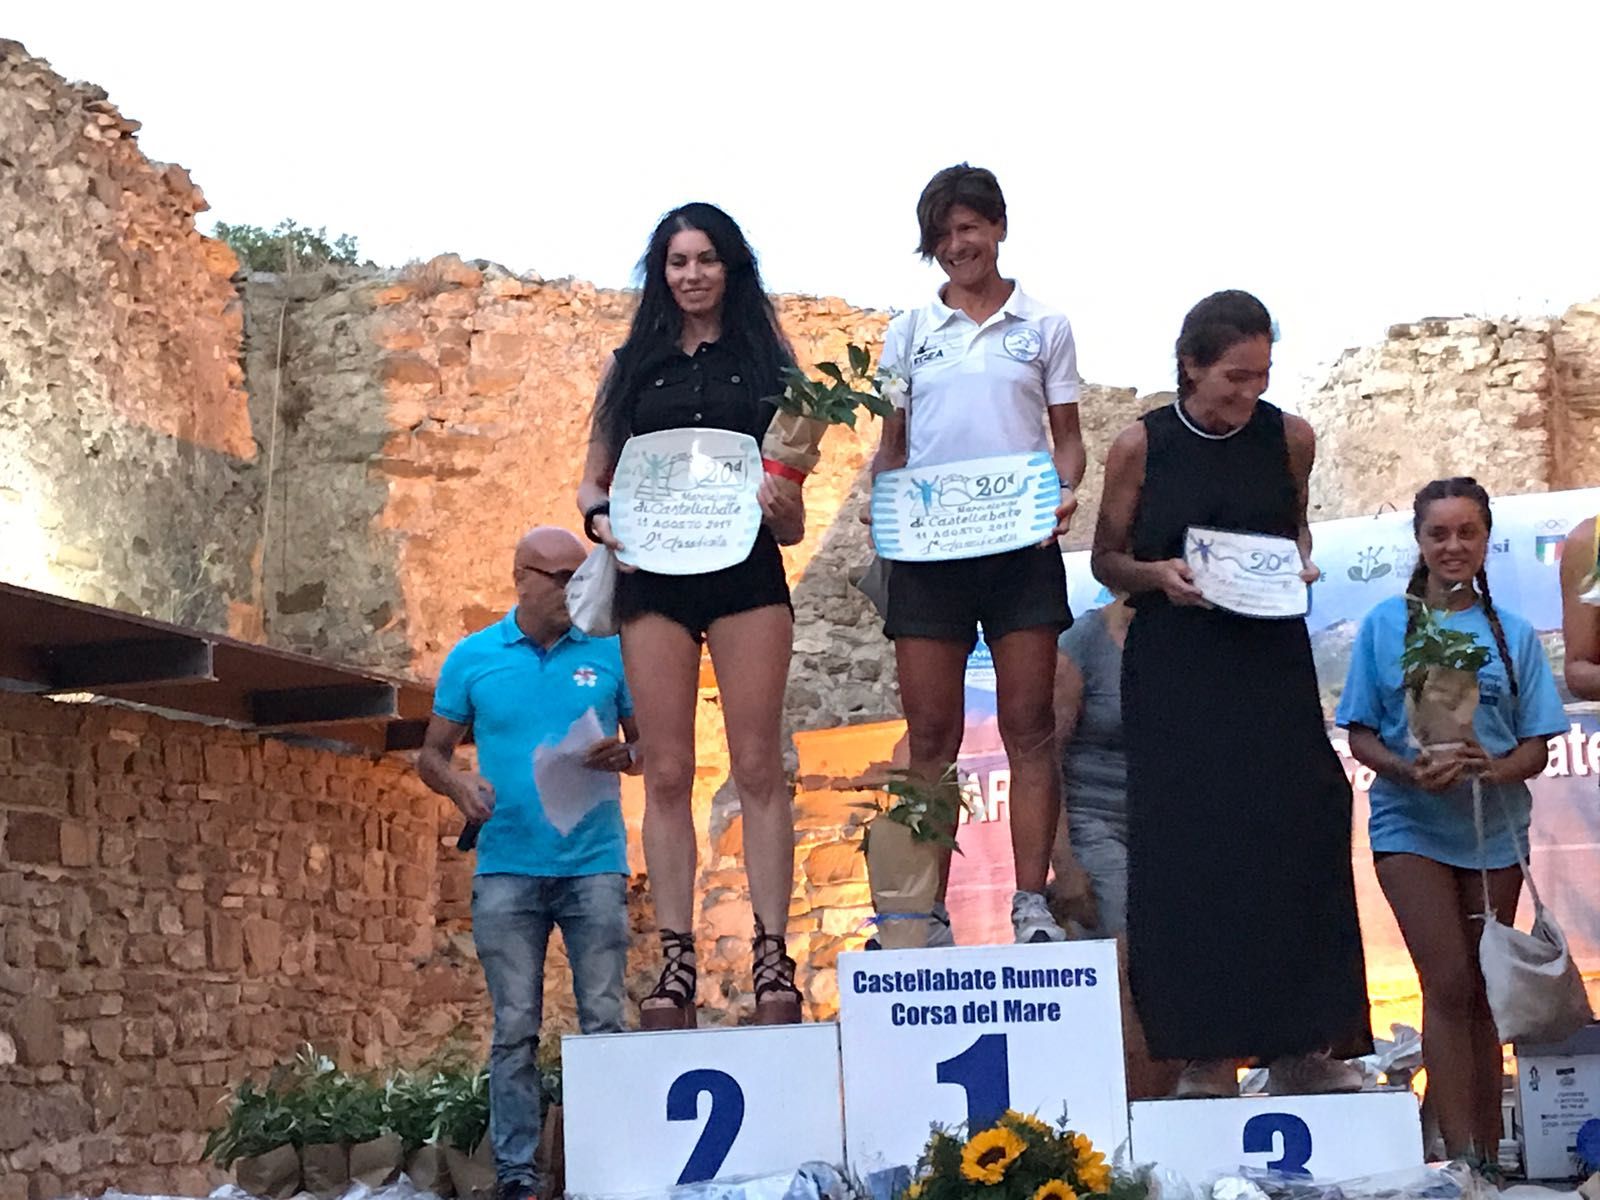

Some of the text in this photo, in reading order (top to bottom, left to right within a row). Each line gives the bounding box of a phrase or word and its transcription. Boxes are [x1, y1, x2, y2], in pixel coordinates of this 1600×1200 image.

[853, 966, 1098, 994] Castellabate Runners
[891, 1000, 1061, 1026] Corsa del Mare
[936, 1033, 1011, 1142] 1
[666, 1068, 745, 1186] 2
[1242, 1112, 1313, 1181] 3
